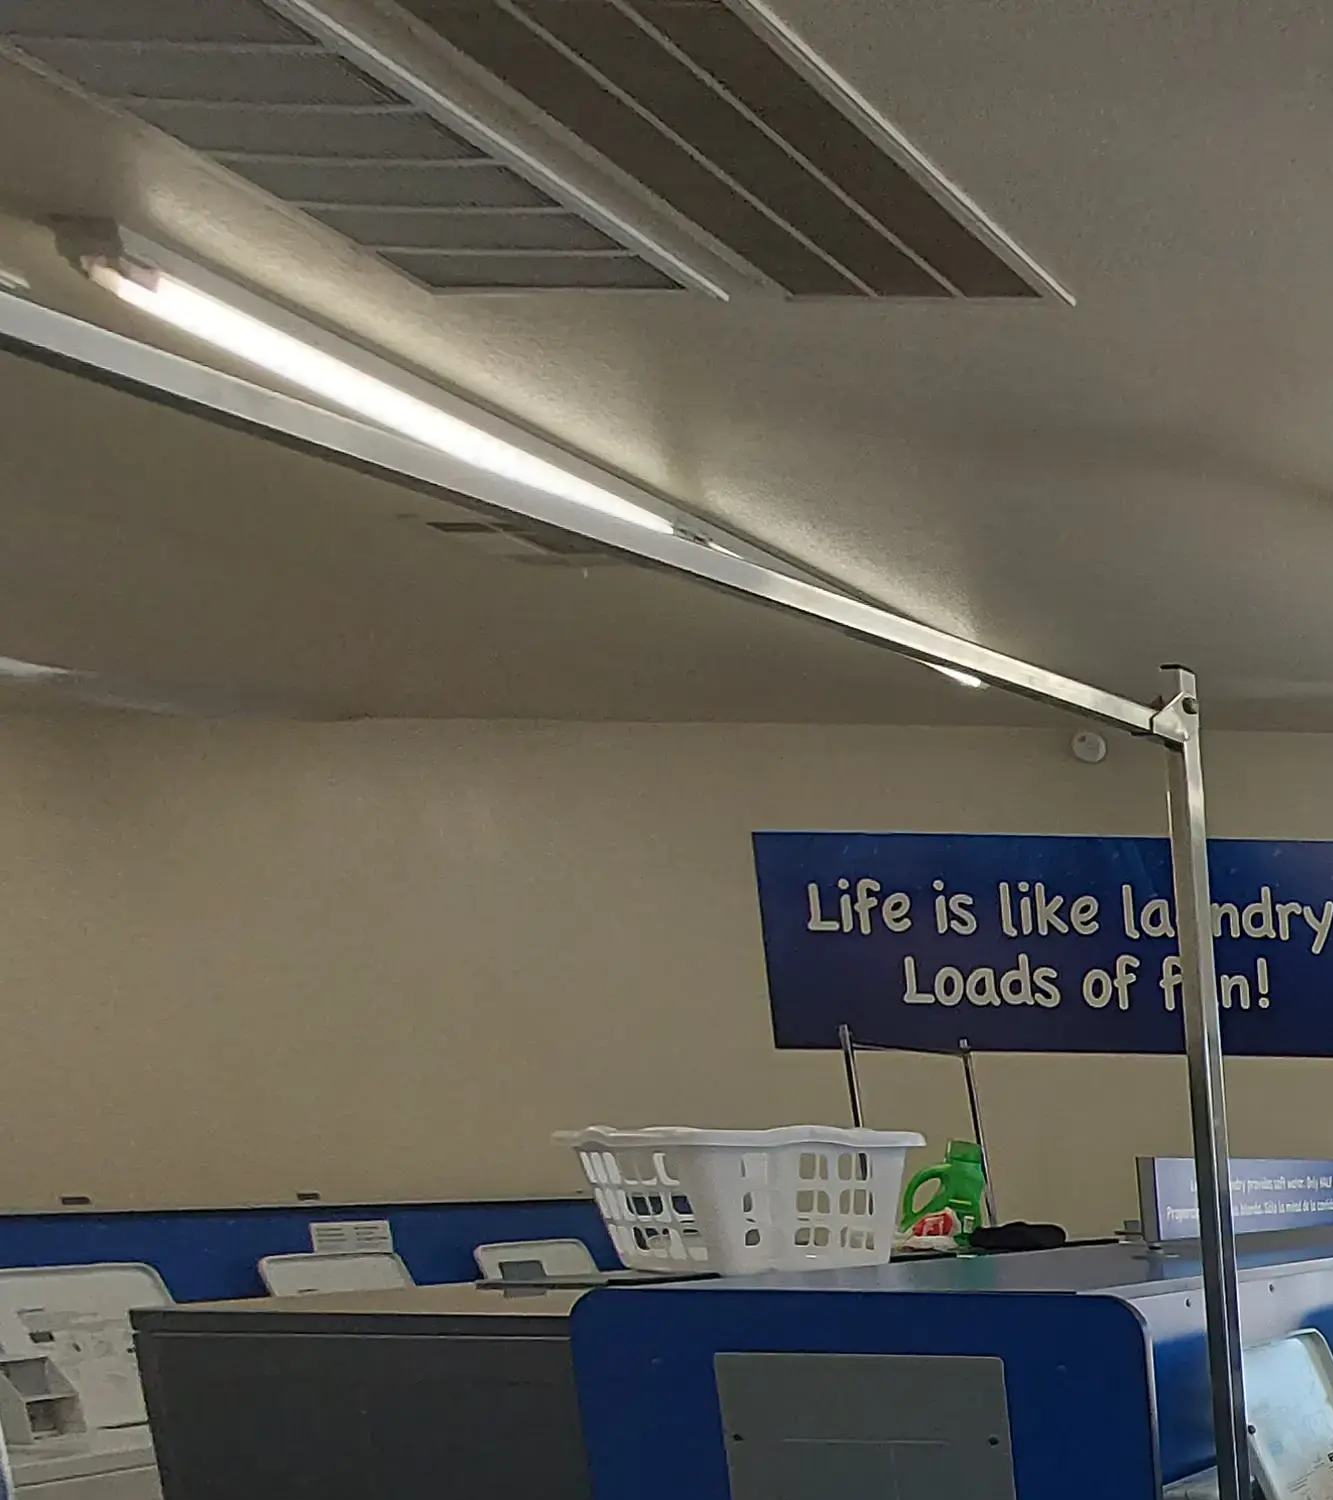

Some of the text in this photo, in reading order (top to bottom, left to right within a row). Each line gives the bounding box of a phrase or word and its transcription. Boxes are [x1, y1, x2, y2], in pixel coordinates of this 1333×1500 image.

[806, 878, 911, 934] Life
[932, 879, 977, 937] is
[998, 881, 1100, 938] like
[902, 954, 1271, 1011] Loads of fn!
